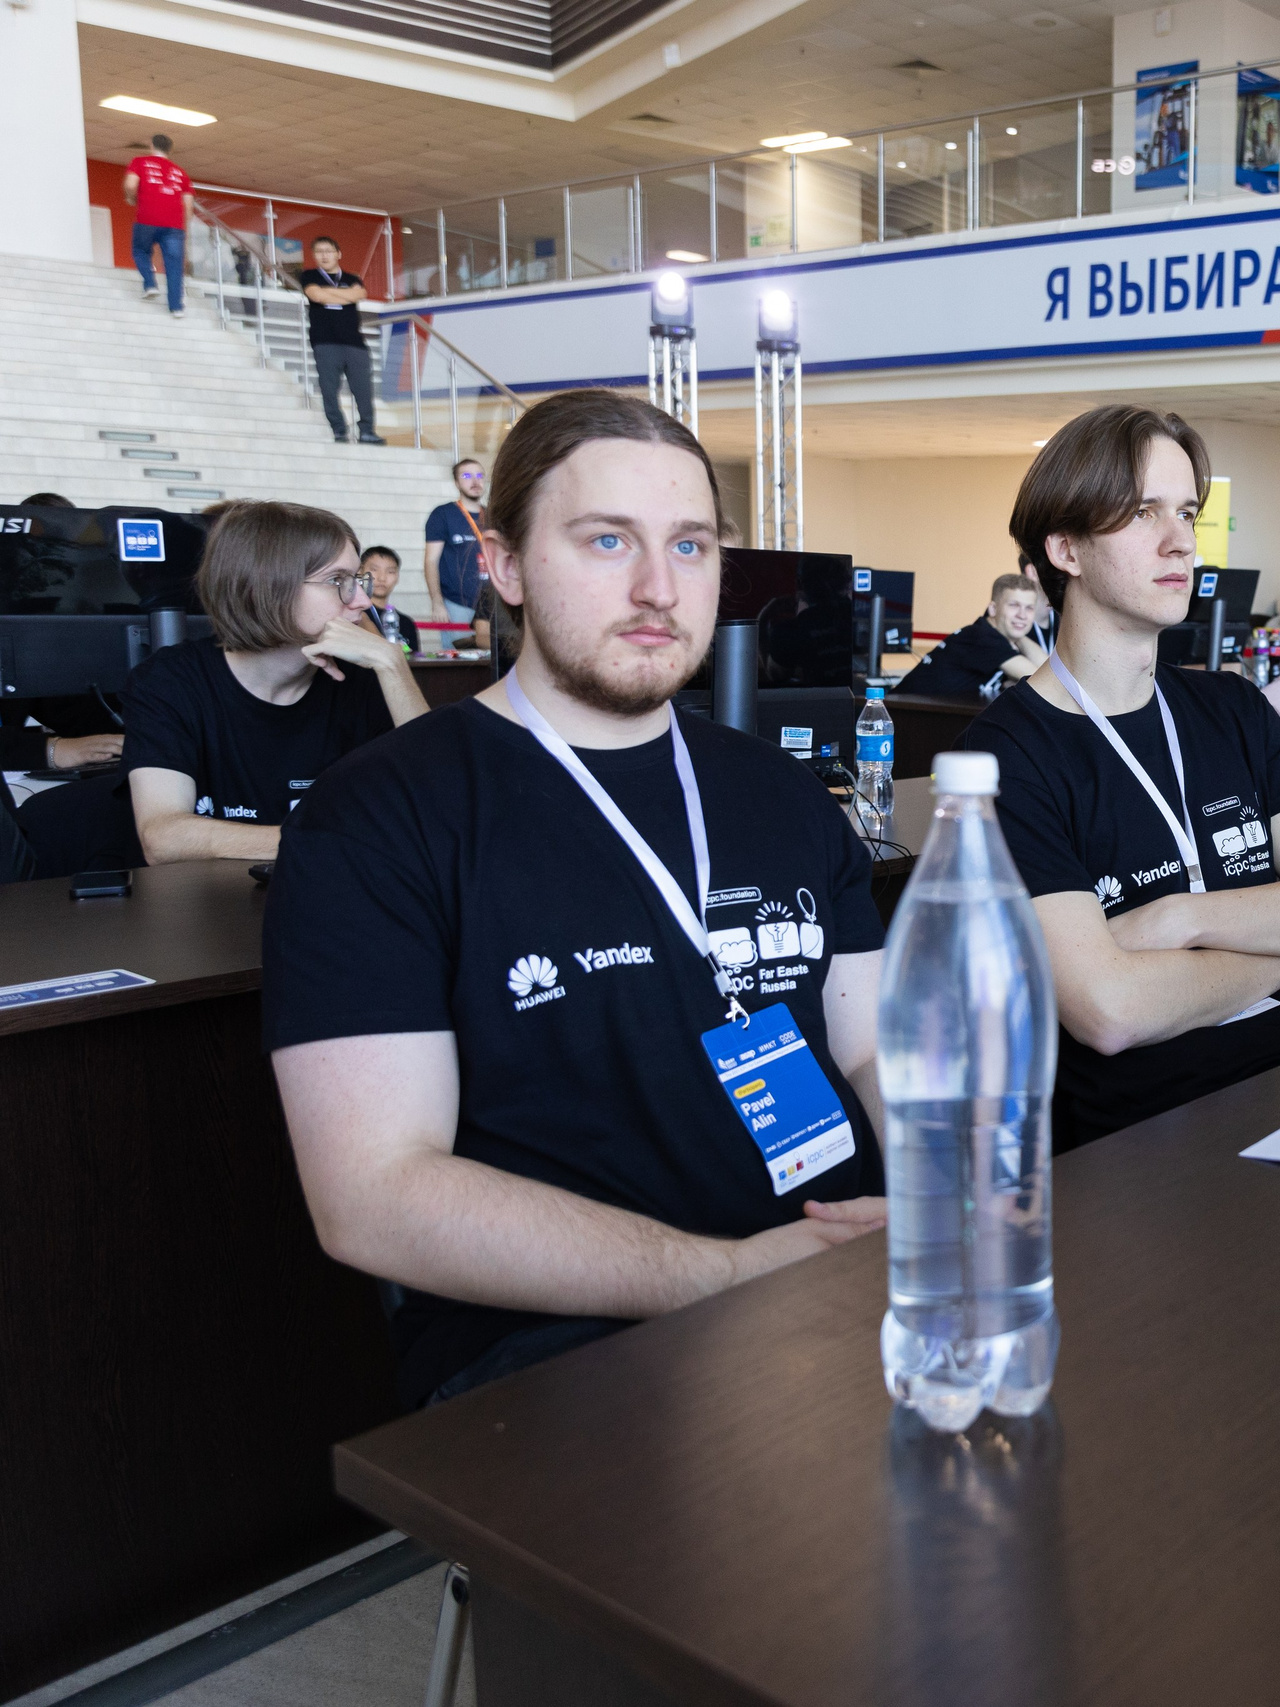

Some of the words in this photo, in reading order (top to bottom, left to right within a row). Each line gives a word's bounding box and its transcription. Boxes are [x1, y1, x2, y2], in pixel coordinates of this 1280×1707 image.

[1044, 266, 1071, 322] Я
[223, 805, 258, 819] Yndex
[1205, 799, 1239, 813] icpc.foundation
[1222, 860, 1250, 877] icpc
[706, 890, 758, 904] cpc.foundation
[1102, 896, 1125, 910] AWEI
[572, 942, 655, 974] Yandex
[759, 967, 775, 980] Far
[777, 964, 810, 978] Easte
[760, 979, 798, 994] Russia
[514, 985, 567, 1012] HUAWEI
[740, 1092, 776, 1117] Pavel
[751, 1112, 778, 1132] Alin
